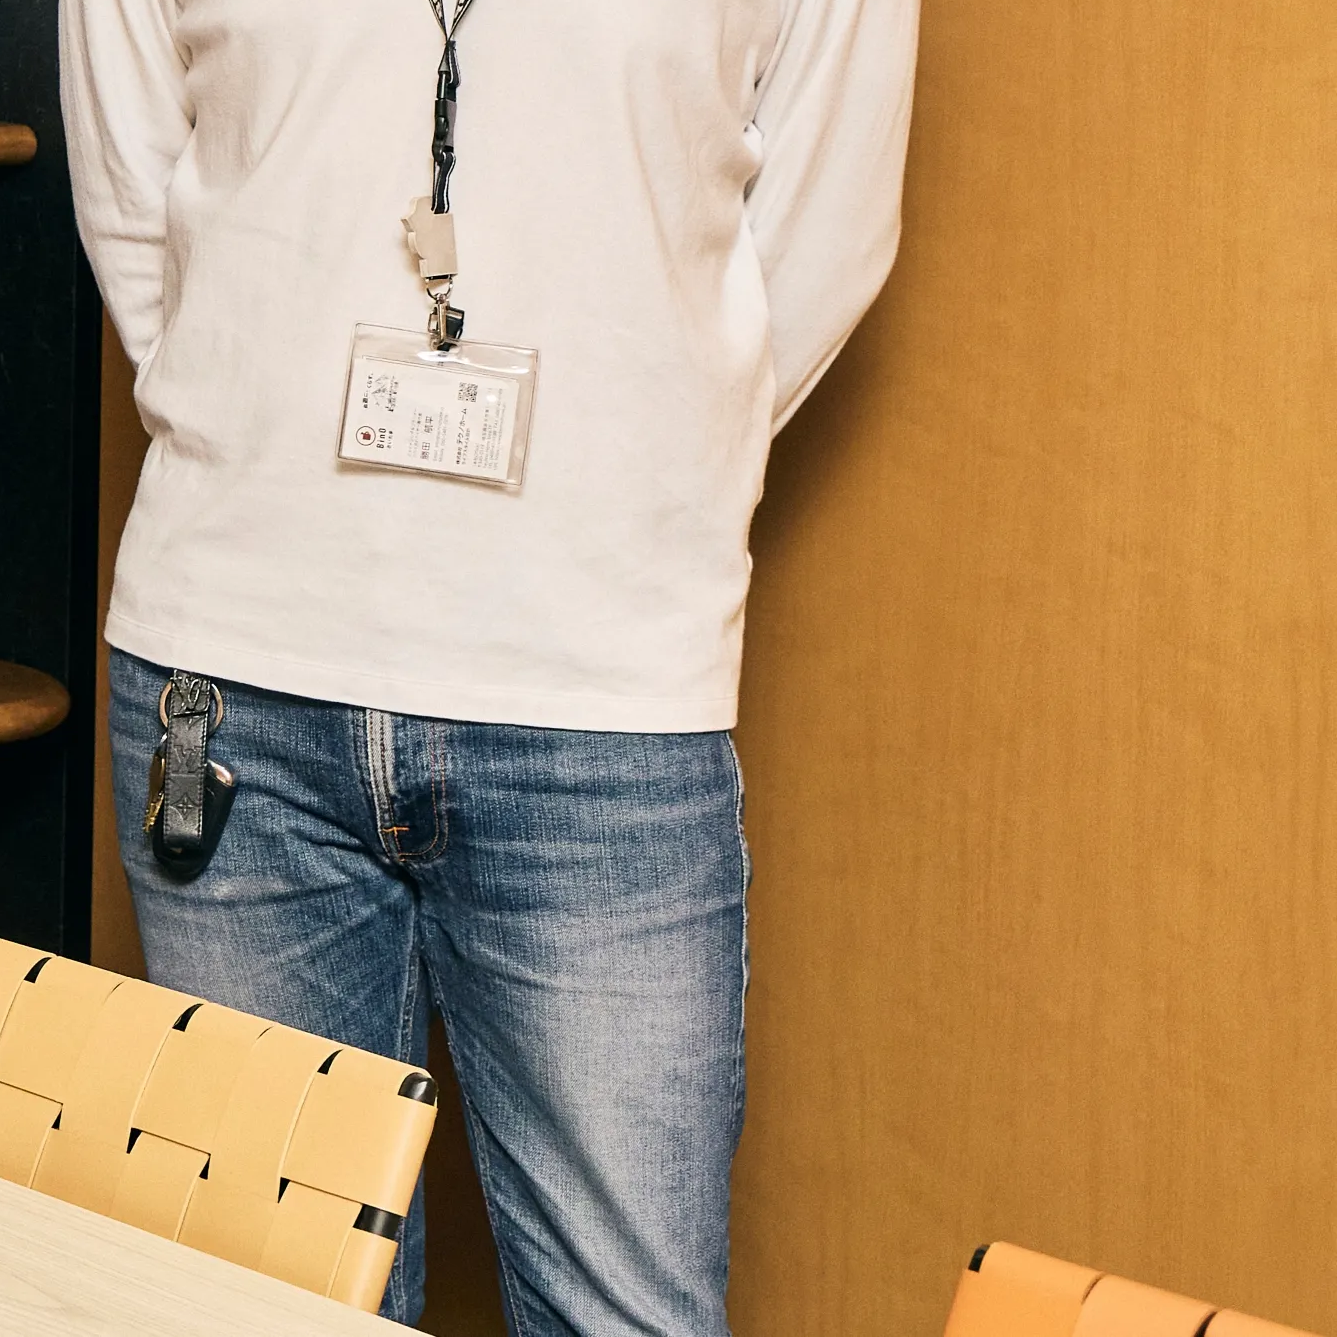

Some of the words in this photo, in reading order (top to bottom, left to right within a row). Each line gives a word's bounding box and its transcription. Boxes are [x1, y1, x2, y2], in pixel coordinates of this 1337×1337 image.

[376, 427, 387, 449] BinO
[456, 408, 468, 445] テクノホーム
